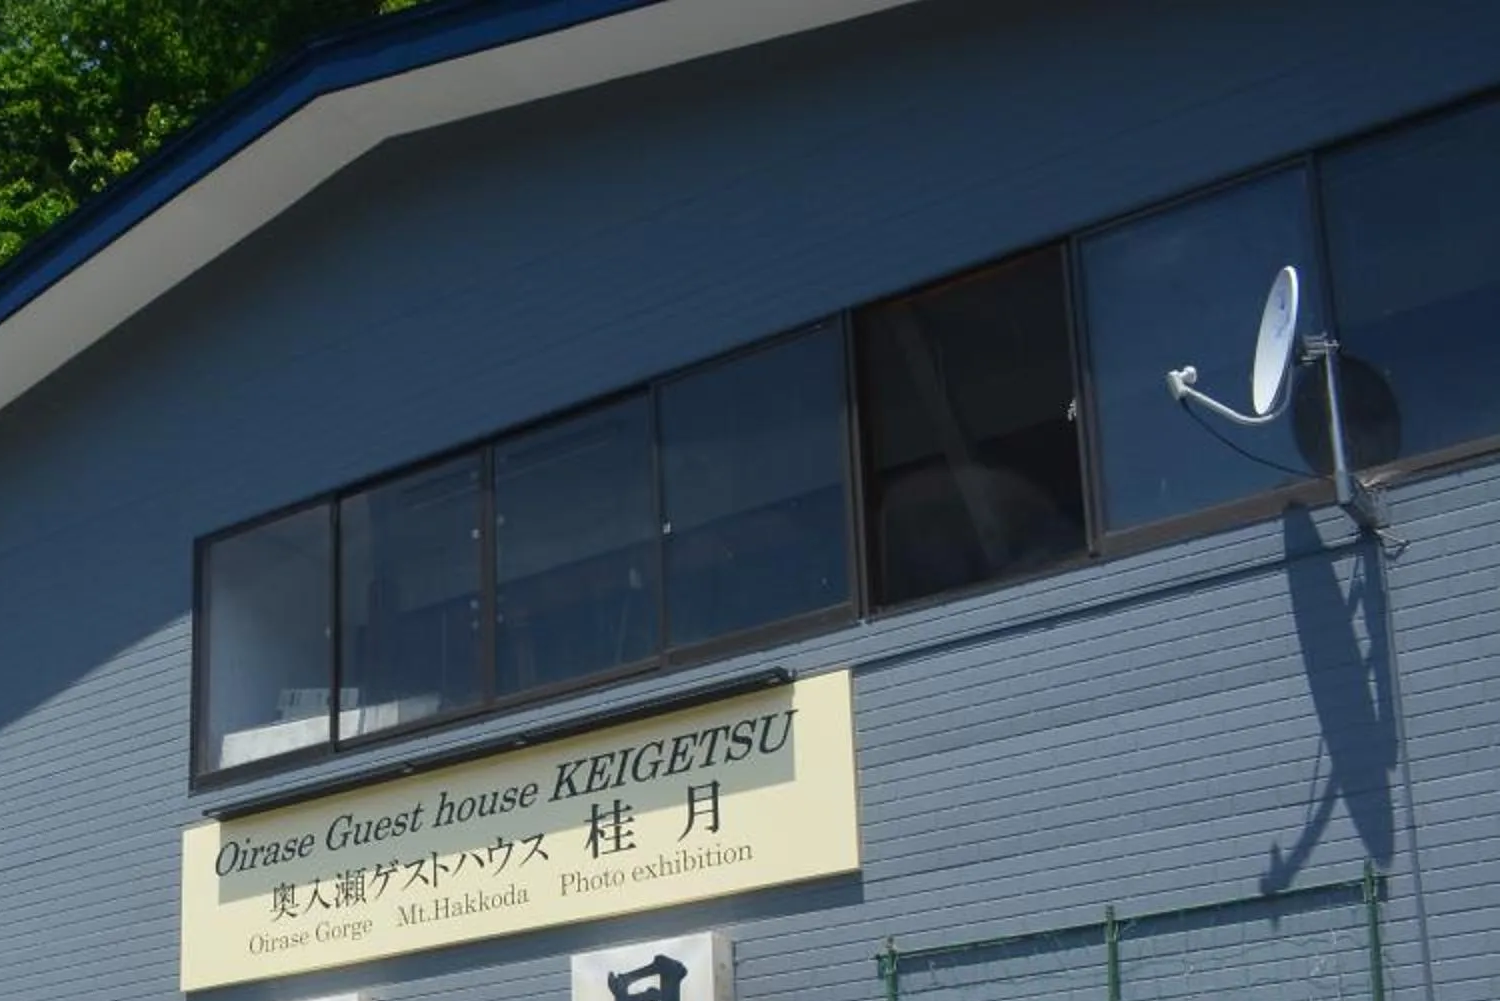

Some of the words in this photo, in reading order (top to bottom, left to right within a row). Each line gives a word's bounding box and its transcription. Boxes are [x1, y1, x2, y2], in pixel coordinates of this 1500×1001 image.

[215, 837, 315, 877] Oirase
[326, 801, 425, 851] Guest
[432, 782, 538, 829] house
[548, 709, 798, 803] KEIGETSU
[269, 832, 550, 922] 奥入瀬ゲストハウス
[584, 799, 637, 860] 桂
[677, 779, 721, 842] 月
[249, 932, 310, 956] Oirase
[315, 916, 373, 943] Gorge
[397, 884, 530, 928] Mt.Hakkoda
[560, 868, 626, 897] Photo
[631, 843, 754, 883] exhibition
